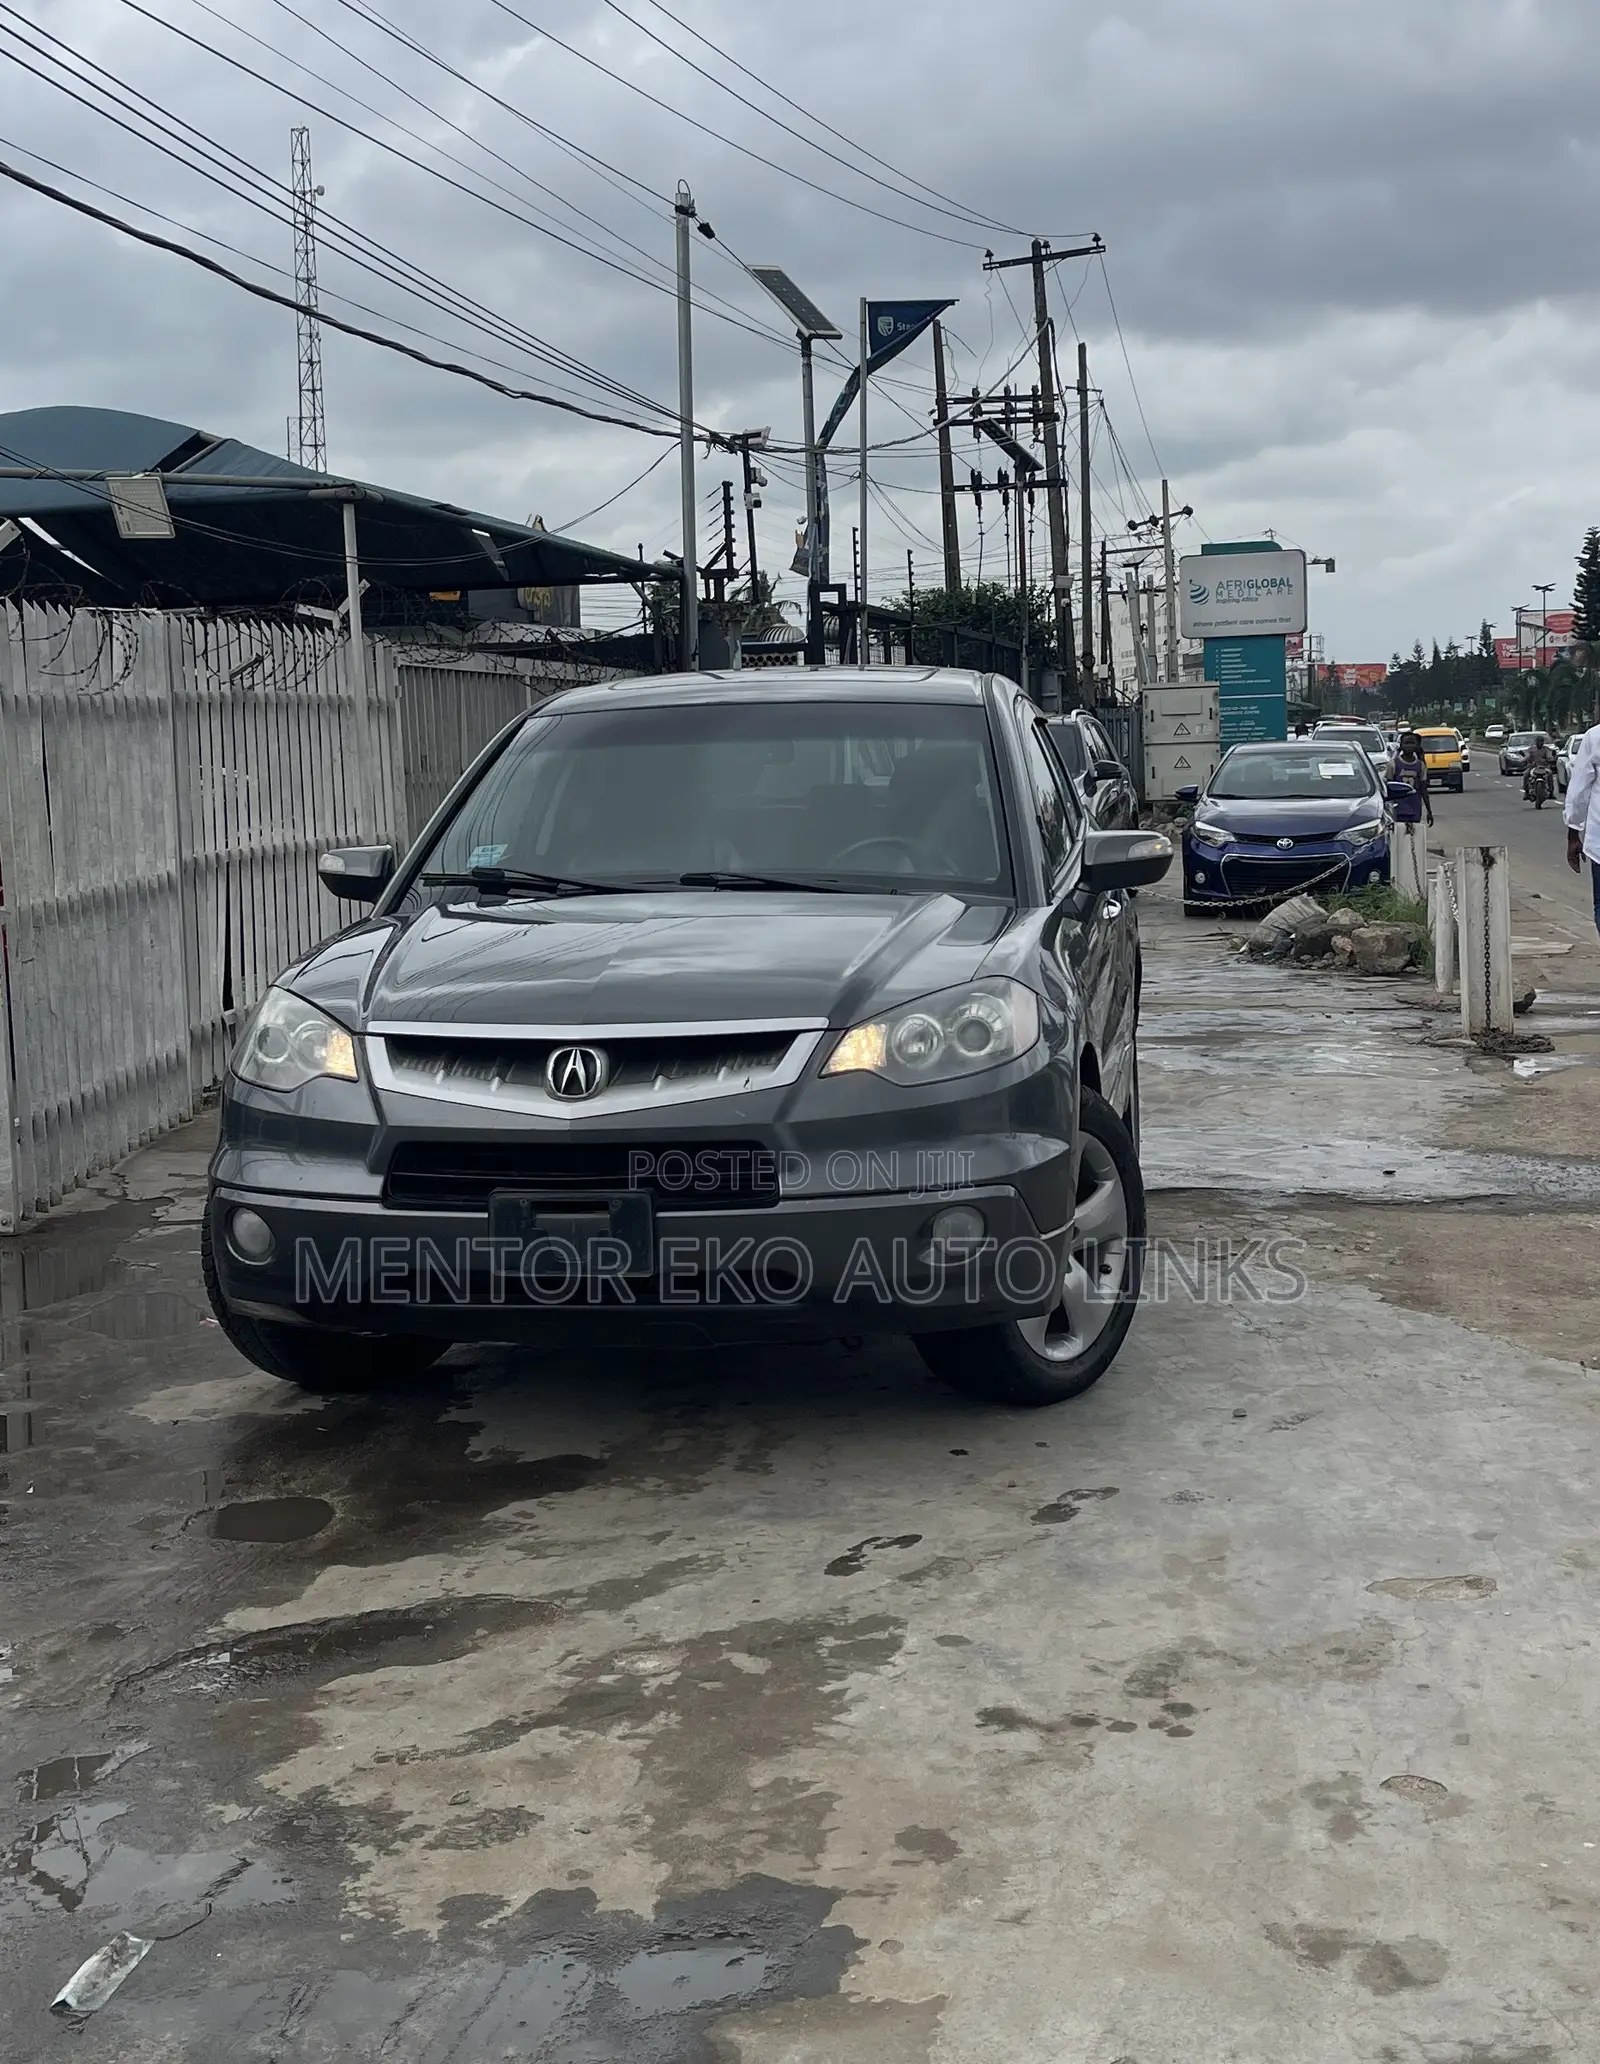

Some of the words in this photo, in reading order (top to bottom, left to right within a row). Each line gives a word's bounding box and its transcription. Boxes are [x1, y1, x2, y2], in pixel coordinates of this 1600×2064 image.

[1216, 577, 1293, 591] AFRIGLOBAL
[1216, 587, 1293, 598] MEDICARE
[1214, 619, 1238, 628] patient
